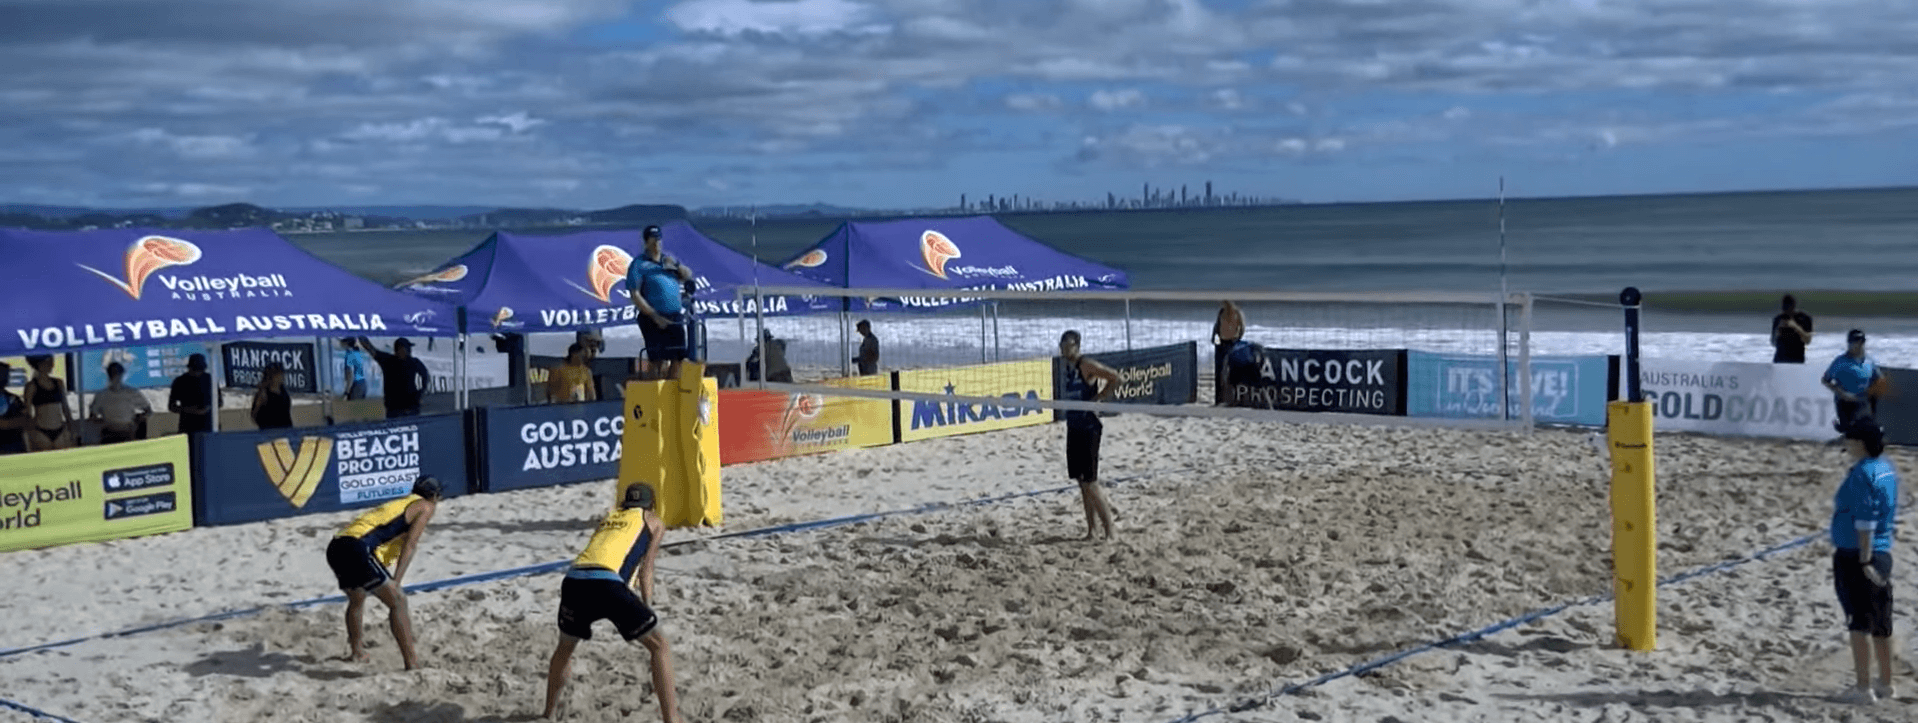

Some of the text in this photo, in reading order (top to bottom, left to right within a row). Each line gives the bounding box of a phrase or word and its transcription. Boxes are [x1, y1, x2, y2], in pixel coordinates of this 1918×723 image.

[159, 273, 287, 292] Volleyball
[171, 290, 293, 301] AUSTRALIA
[540, 296, 788, 326] VOLLEYB USTRALIA
[17, 314, 387, 349] VOLLEYBALL AUSTRALIA
[230, 348, 304, 370] HANCOCK
[1256, 355, 1384, 385] ANCOCK
[233, 369, 306, 388] PROSPING
[1114, 380, 1154, 399] World
[1642, 371, 1739, 390] AUSTRALIA'S
[1236, 384, 1385, 409] PROSPECTING
[911, 389, 1043, 430] MIKASA
[521, 420, 589, 444] GOLD
[793, 424, 850, 445] Volleyball
[337, 433, 419, 459] BEACH
[522, 439, 623, 472] AUSTRA
[338, 453, 419, 475] PRO TOUR
[124, 473, 171, 487] App Store
[341, 472, 419, 490] GOLD COAST
[357, 487, 405, 499] FUTURES
[0, 508, 41, 530] rld
